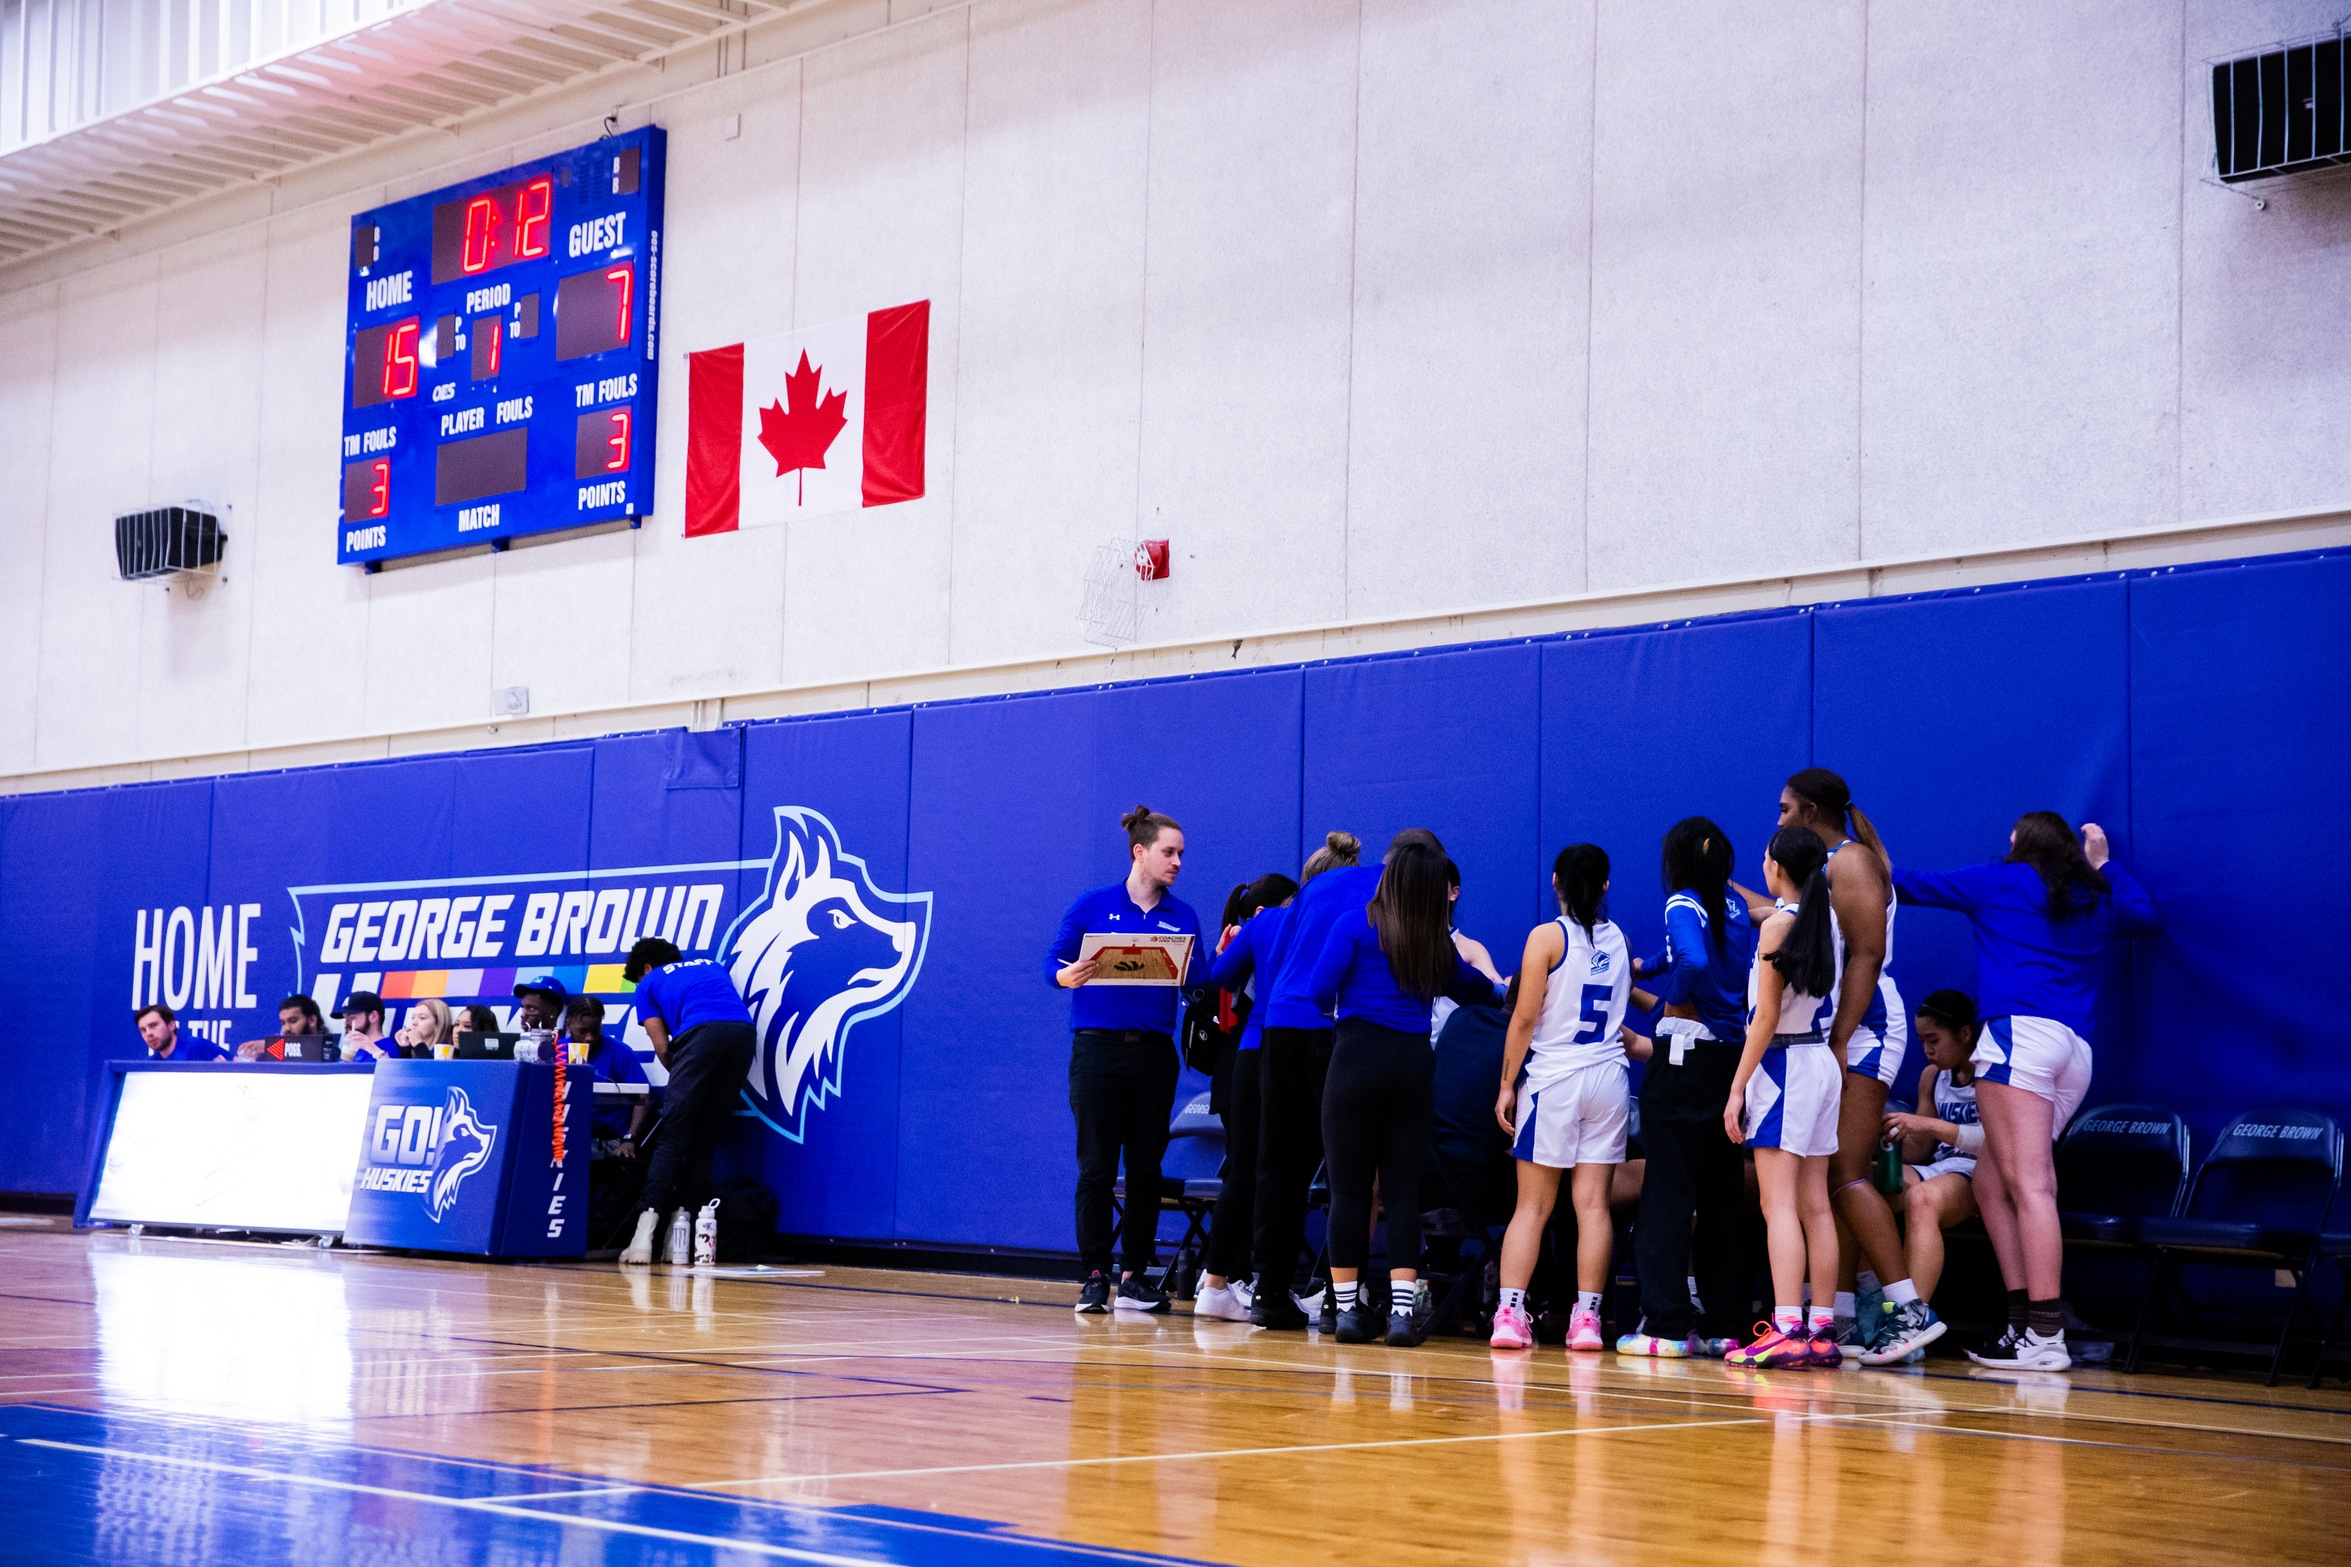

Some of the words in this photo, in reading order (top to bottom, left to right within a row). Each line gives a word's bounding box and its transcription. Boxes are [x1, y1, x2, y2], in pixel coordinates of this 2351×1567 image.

[464, 180, 550, 273] 0:12
[568, 211, 627, 258] GUEST
[366, 270, 413, 312] HOME
[466, 283, 511, 315] PERIOD
[606, 269, 629, 340] 7
[455, 316, 462, 333] P
[514, 301, 521, 319] P
[455, 333, 466, 351] TO
[489, 323, 500, 371] 1
[509, 321, 521, 339] TO
[384, 323, 417, 395] 15
[576, 385, 594, 408] TM
[598, 373, 637, 404] FOULS
[441, 407, 484, 436] PLAYER
[496, 396, 533, 424] FOULS
[344, 435, 360, 457] TM
[363, 426, 397, 453] FOULS
[607, 412, 628, 470] 3
[370, 461, 389, 515] 3
[578, 480, 626, 510] POINTS
[458, 504, 500, 532] MATCH
[345, 525, 386, 552] POINTS
[320, 893, 515, 963] GEORGE
[515, 884, 724, 956] BROWN
[131, 903, 261, 1011] HOME
[1572, 984, 1613, 1045] 5
[1938, 1101, 1979, 1124] HUSKIE
[2084, 1119, 2129, 1133] GEORGE
[2128, 1121, 2171, 1135] BROWN
[370, 1105, 443, 1166] GO!
[2233, 1124, 2280, 1138] GEORGE
[2279, 1126, 2323, 1140] BROWN
[360, 1167, 434, 1194] HUSKIES
